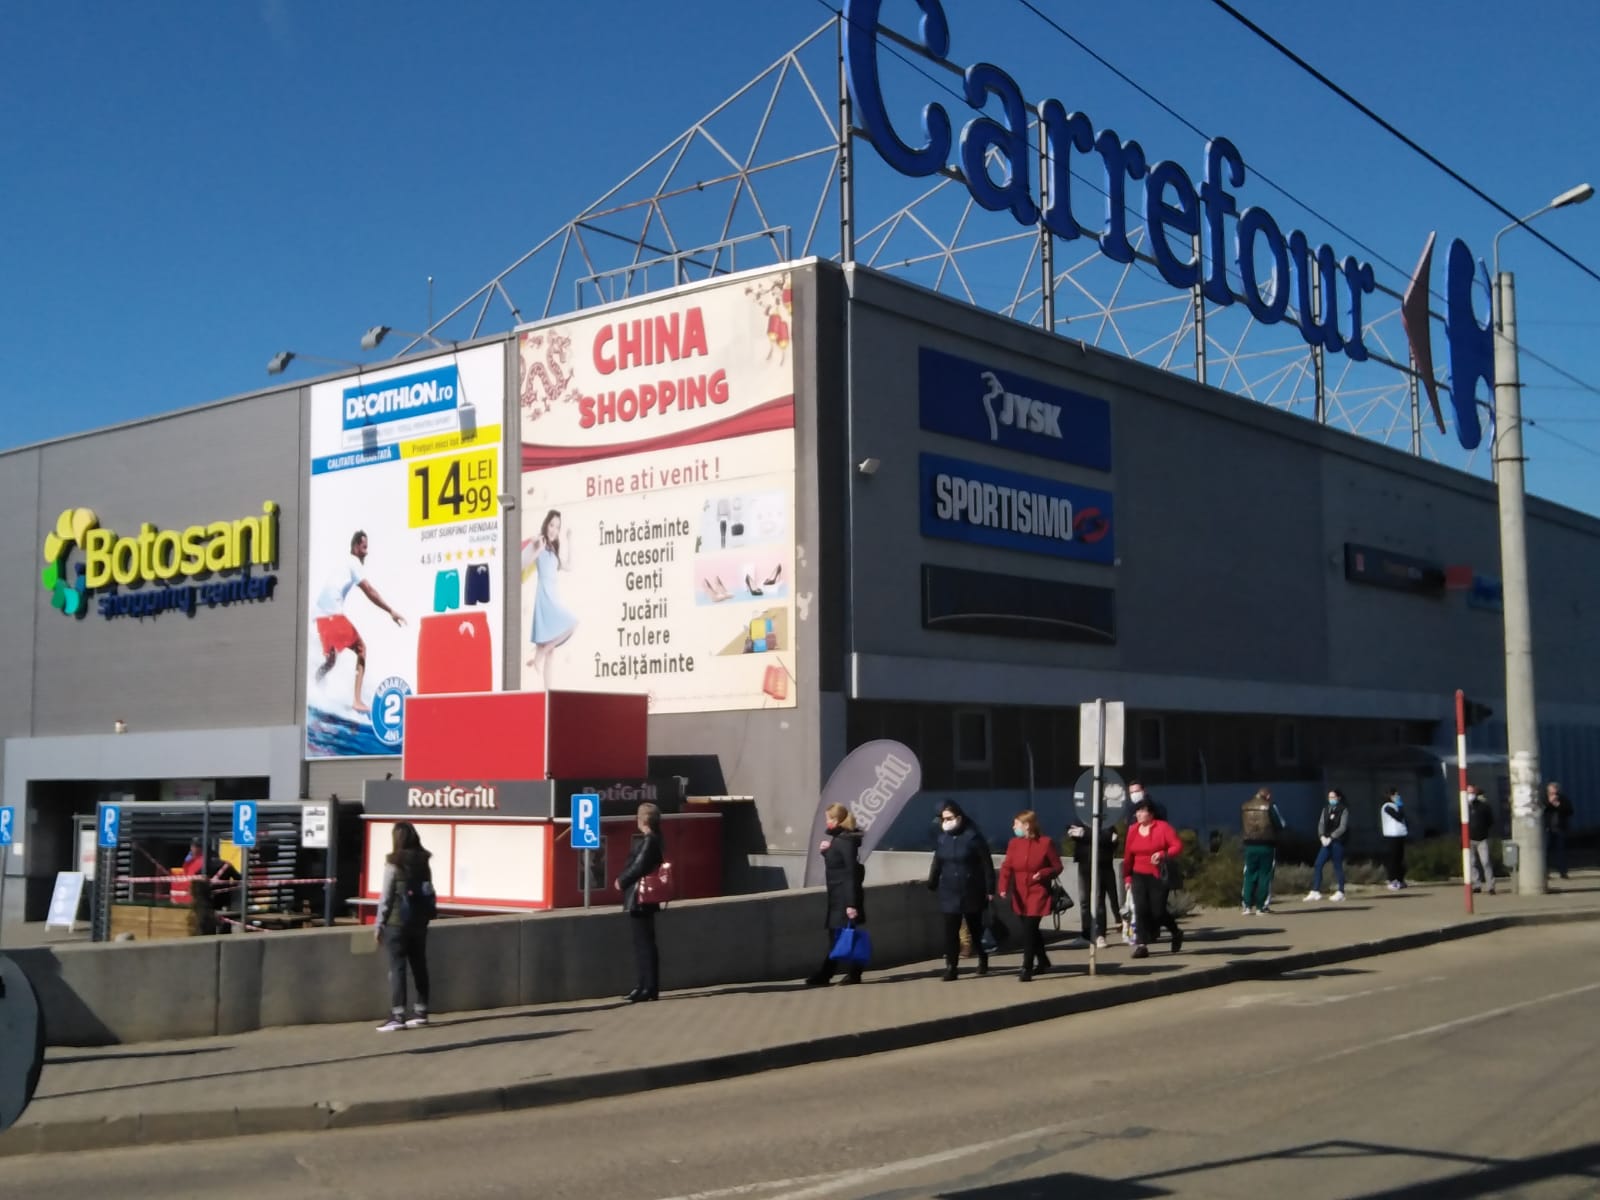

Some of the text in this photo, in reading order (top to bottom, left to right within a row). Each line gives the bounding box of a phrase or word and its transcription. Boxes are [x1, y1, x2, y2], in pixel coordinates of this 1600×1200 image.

[843, 0, 1375, 362] Carrefour
[592, 306, 708, 375] CHINA
[346, 380, 453, 420] DECATHLON.ro
[578, 368, 729, 429] SHOPPING
[1000, 392, 1063, 439] JYSK
[415, 459, 492, 520] 14 LEI
[586, 474, 624, 497] Bine
[660, 459, 709, 486] venit
[466, 486, 491, 513] 99
[936, 473, 1073, 541] SPORTISIMO
[86, 500, 277, 590] Botosani
[600, 517, 689, 546] Îmbrăcăminte
[615, 541, 674, 567] Accesorii
[626, 568, 663, 593] Genți
[621, 597, 668, 622] Jucării
[617, 626, 670, 647] Trolere
[594, 651, 695, 680] Încălțăminte
[384, 694, 401, 724] 2
[408, 785, 496, 808] RotiGrill
[104, 806, 116, 833] P
[239, 803, 251, 830] P
[578, 798, 593, 830] P
